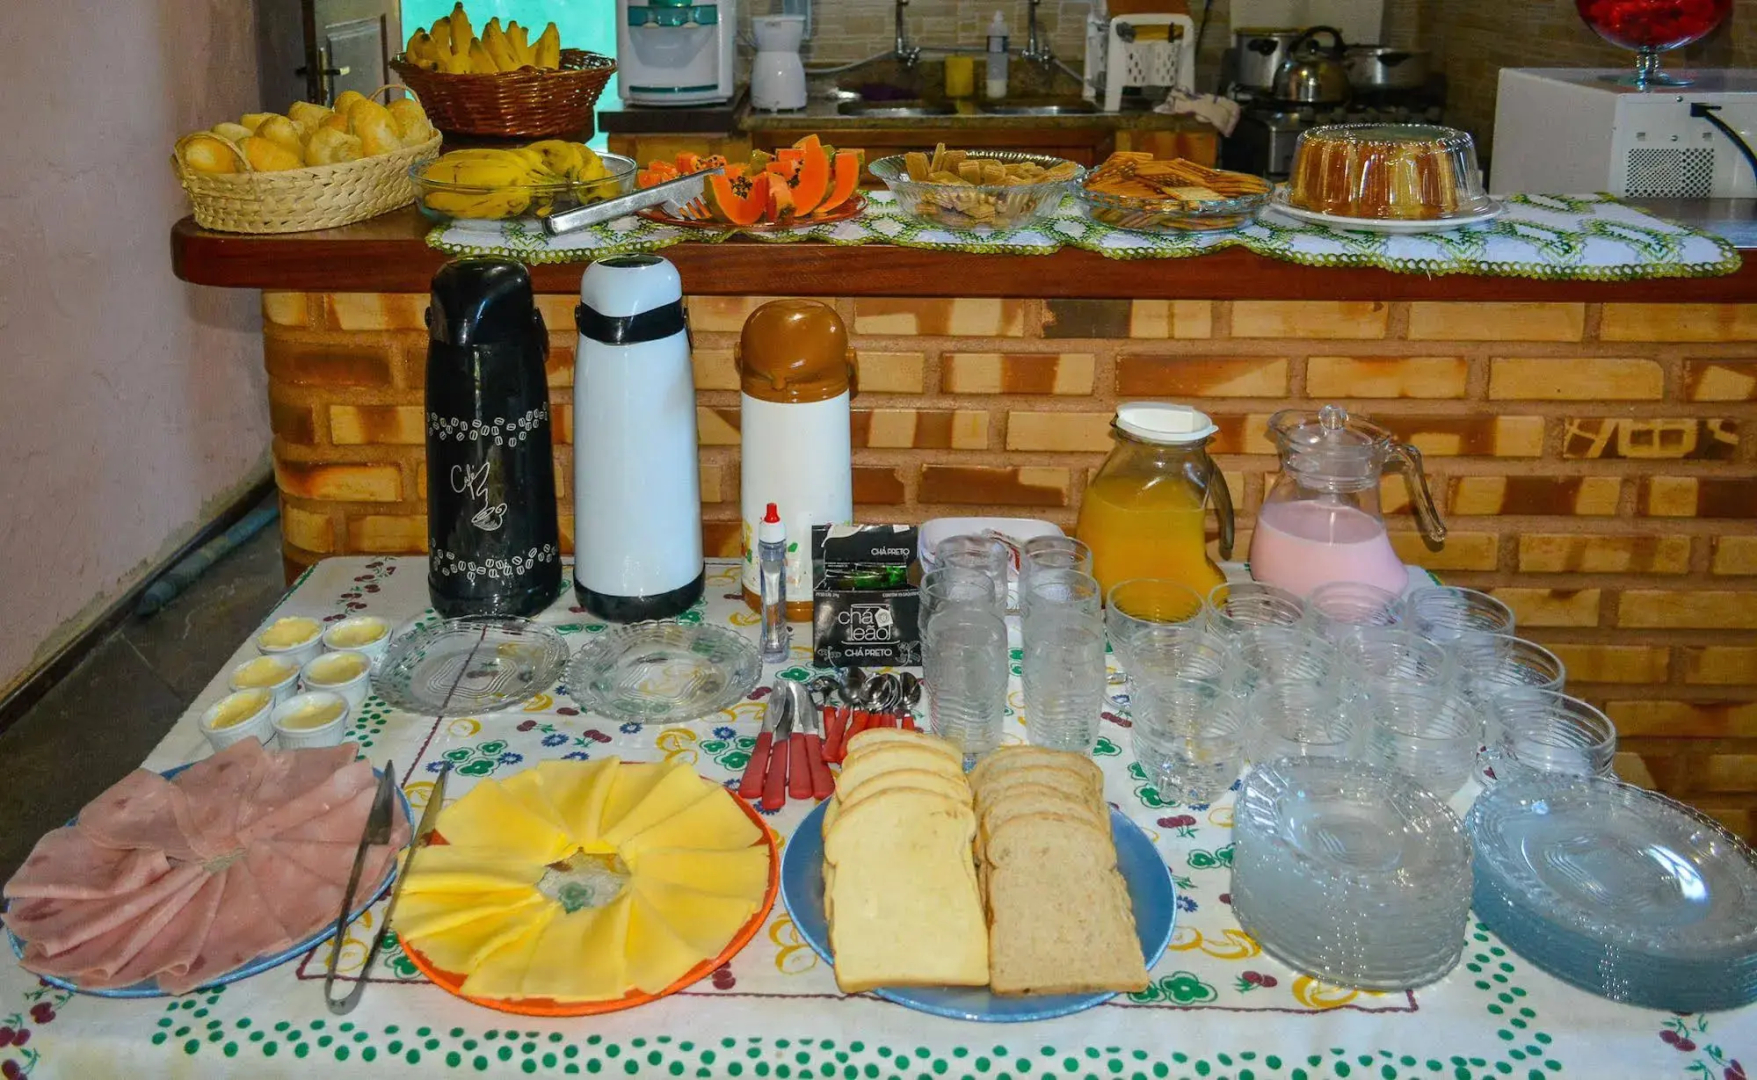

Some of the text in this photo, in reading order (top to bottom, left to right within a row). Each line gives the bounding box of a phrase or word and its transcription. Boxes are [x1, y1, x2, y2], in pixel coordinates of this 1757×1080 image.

[871, 546, 910, 556] CHÁ PRETO
[838, 608, 874, 625] chá
[850, 625, 889, 641] leão
[845, 647, 893, 657] CHÁ PRETO
